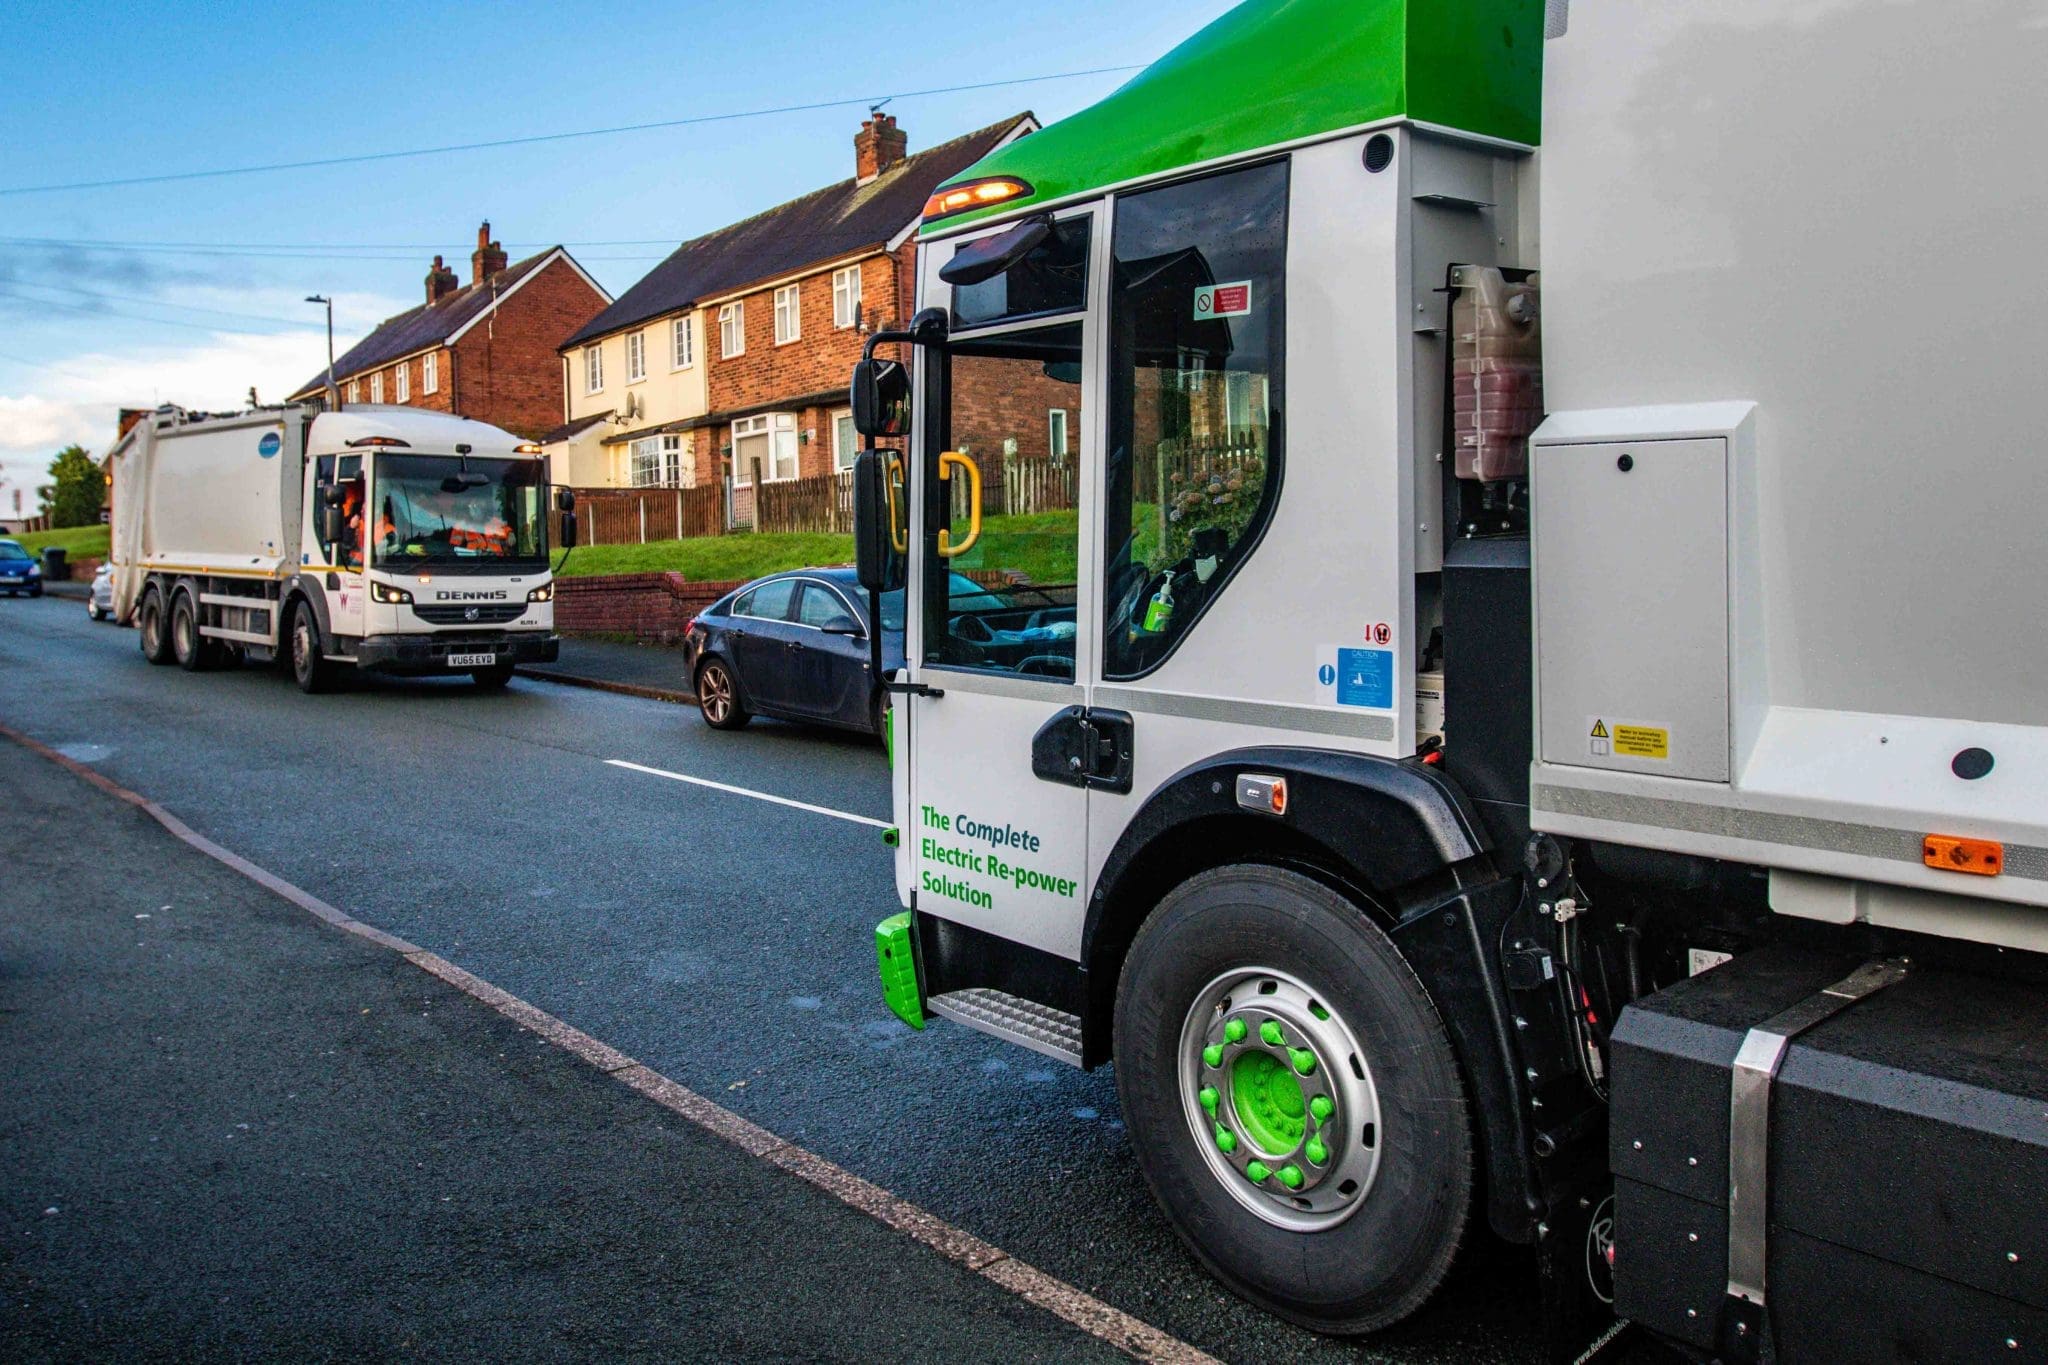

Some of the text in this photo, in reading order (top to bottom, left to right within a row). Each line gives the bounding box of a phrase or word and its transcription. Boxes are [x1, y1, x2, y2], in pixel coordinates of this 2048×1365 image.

[436, 590, 507, 600] DENNIS
[451, 655, 474, 665] VU65
[1352, 650, 1378, 658] CAUTION
[922, 805, 1040, 852] The Complete
[922, 838, 1077, 898] Electric Re-power
[922, 870, 992, 909] Solution
